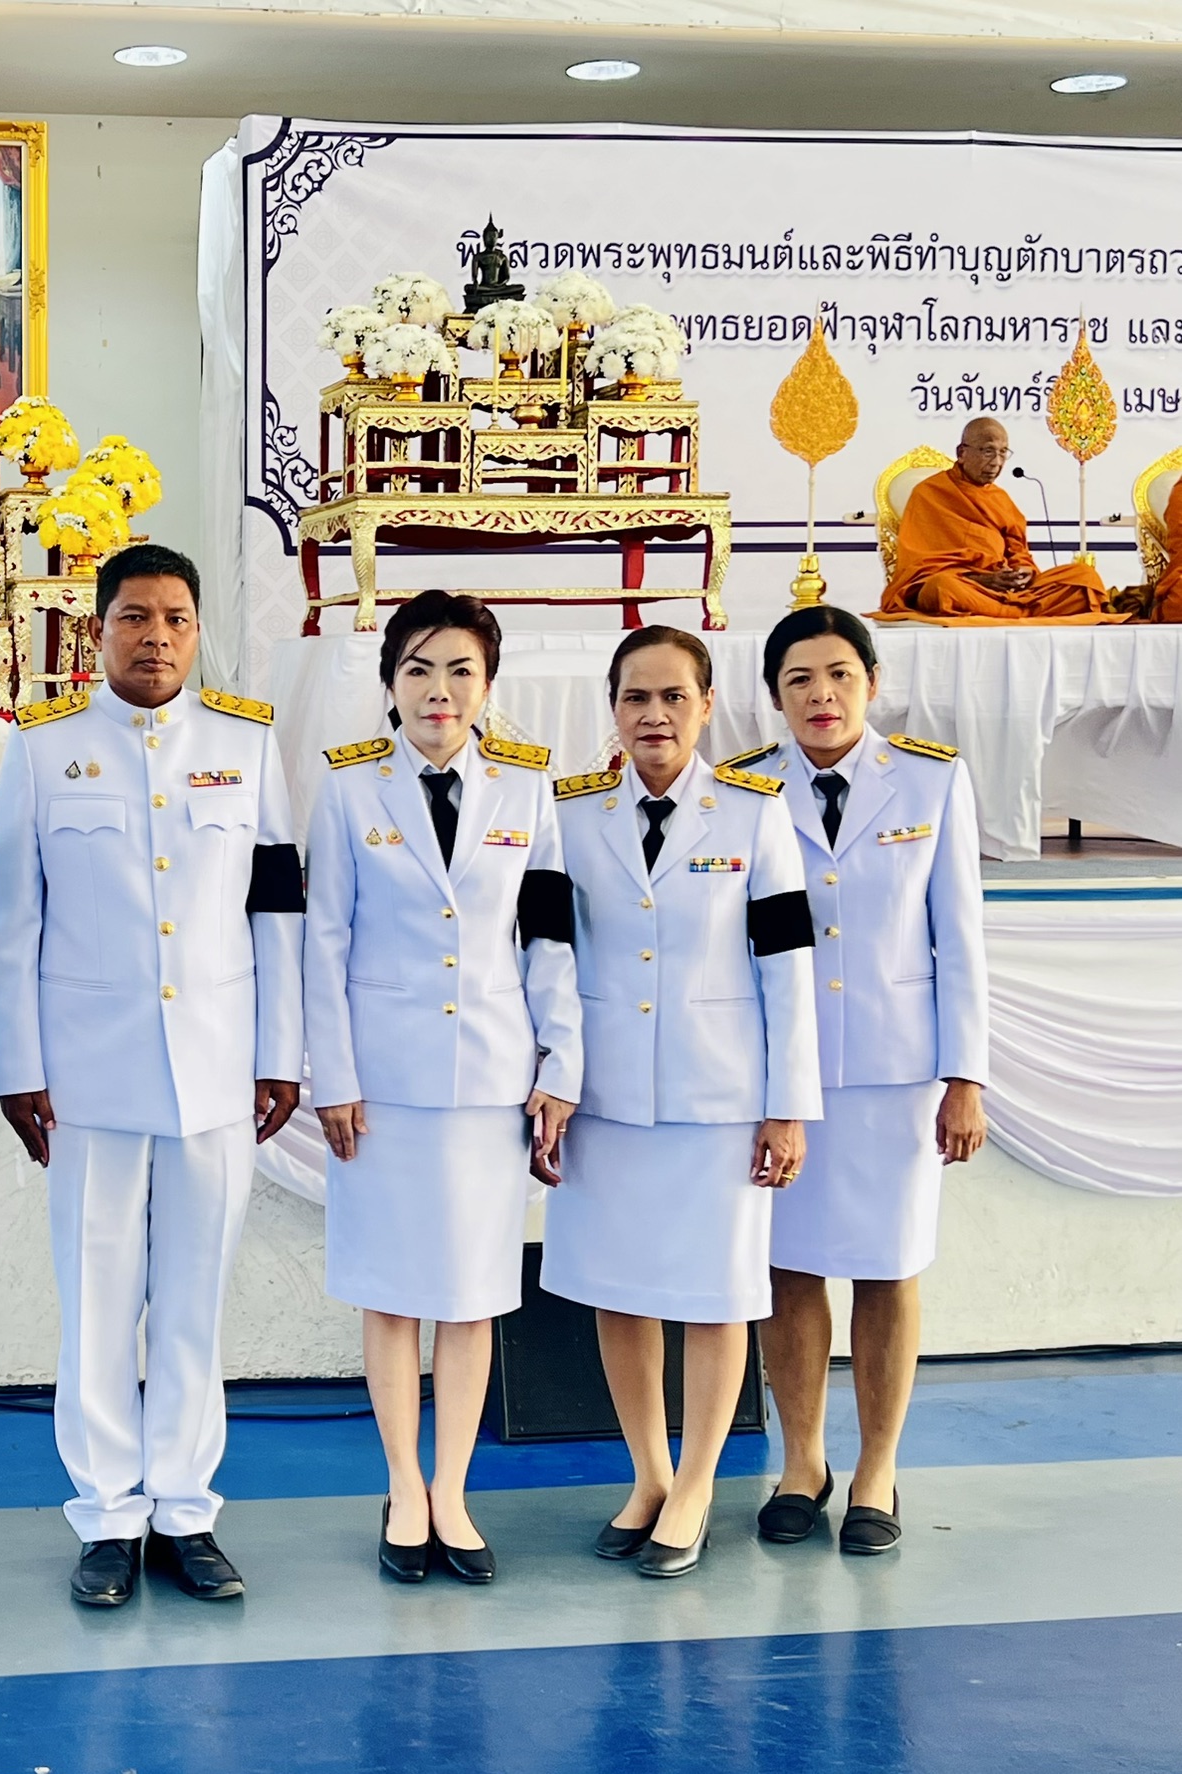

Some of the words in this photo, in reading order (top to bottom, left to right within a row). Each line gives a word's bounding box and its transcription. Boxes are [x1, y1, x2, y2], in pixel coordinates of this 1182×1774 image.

[456, 228, 1182, 285] พิสวดพระพุทธมนต์และพิธีทำบุญตักบาตรถว
[911, 370, 1059, 412] วันจันทร์
[1123, 387, 1181, 413] เมษ
